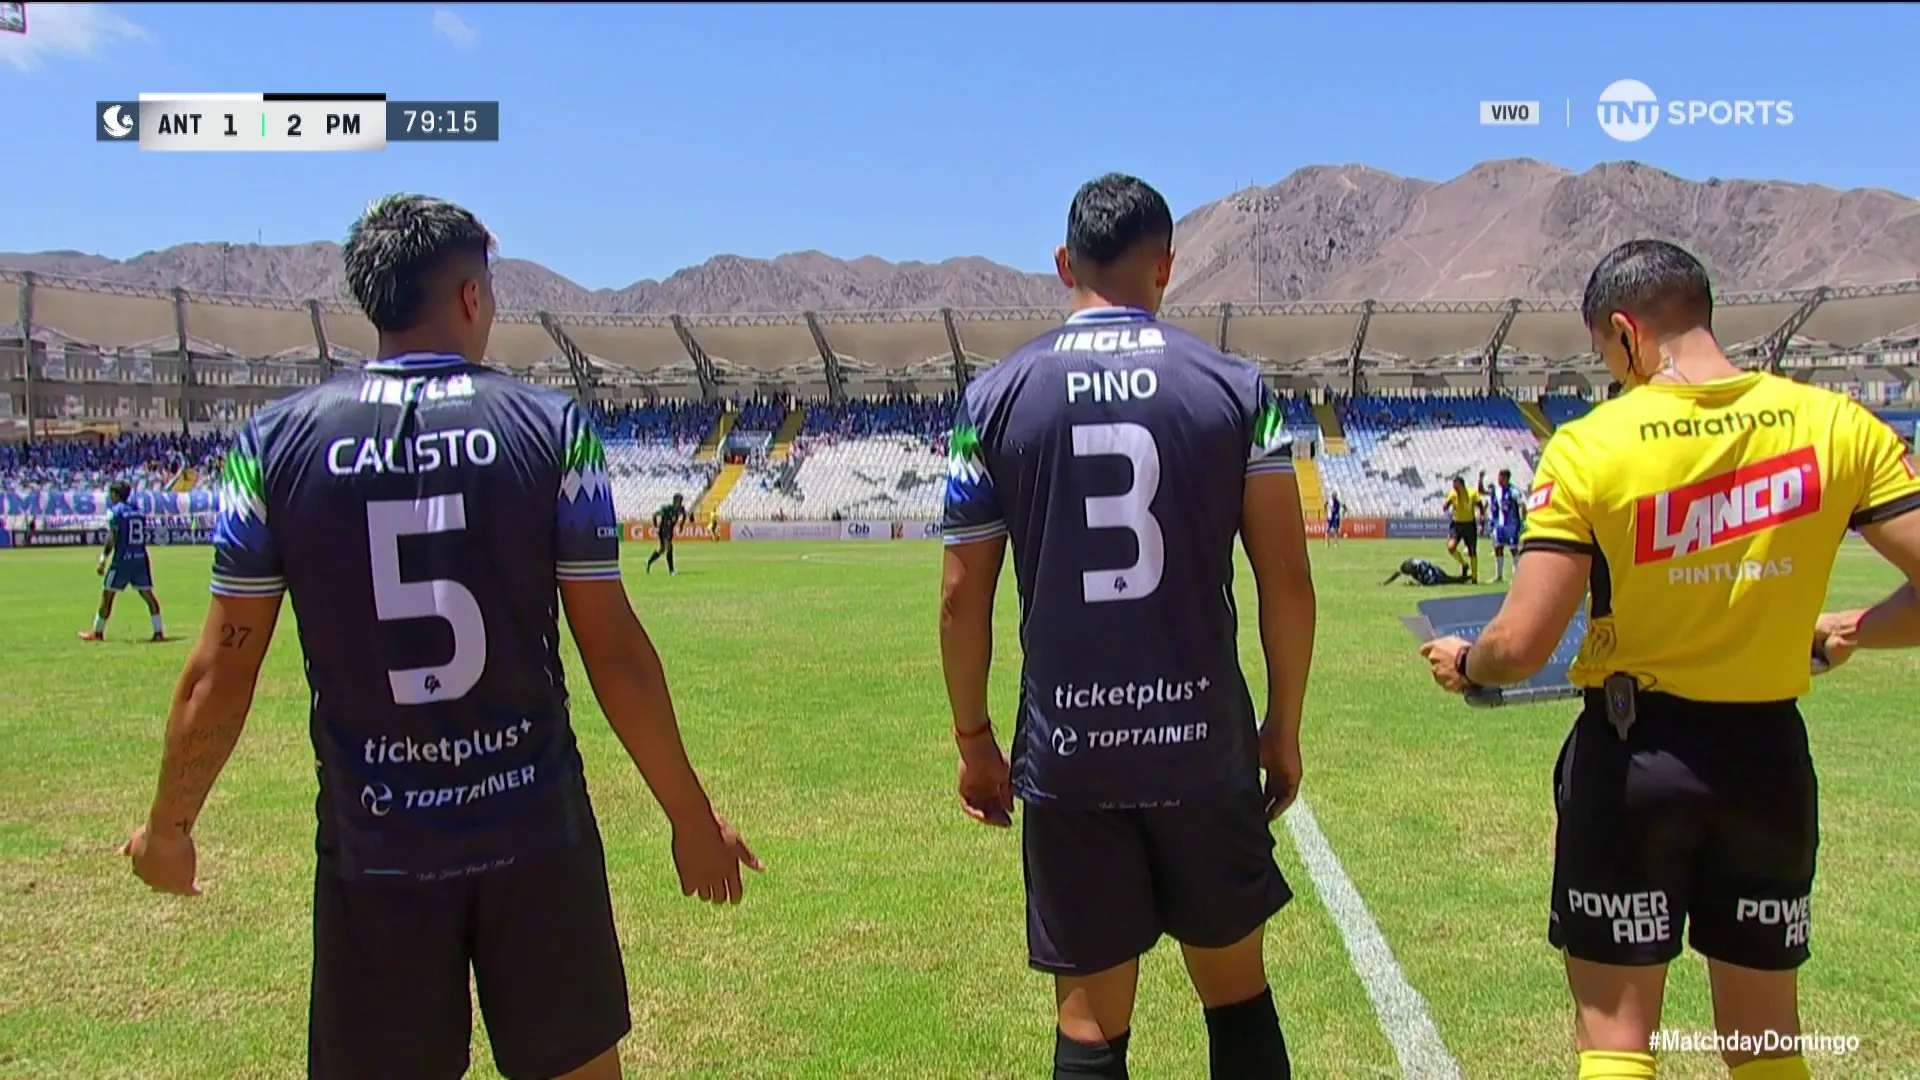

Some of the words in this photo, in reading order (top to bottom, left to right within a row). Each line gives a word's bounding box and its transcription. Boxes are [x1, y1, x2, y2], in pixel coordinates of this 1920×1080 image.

[1066, 368, 1158, 403] PINO
[1640, 408, 1795, 441] marathon
[327, 428, 497, 475] CALISTO
[1071, 422, 1165, 603] 3
[1653, 466, 1803, 557] LANCO
[1668, 556, 1793, 586] PINTURAS
[366, 493, 487, 705] 5
[220, 623, 252, 649] 27
[1087, 722, 1208, 749] TOPTAINER
[403, 764, 535, 810] TOPTAINER
[1568, 889, 1669, 919] POWER
[1736, 897, 1810, 924] POWE
[1613, 915, 1670, 944] ADE
